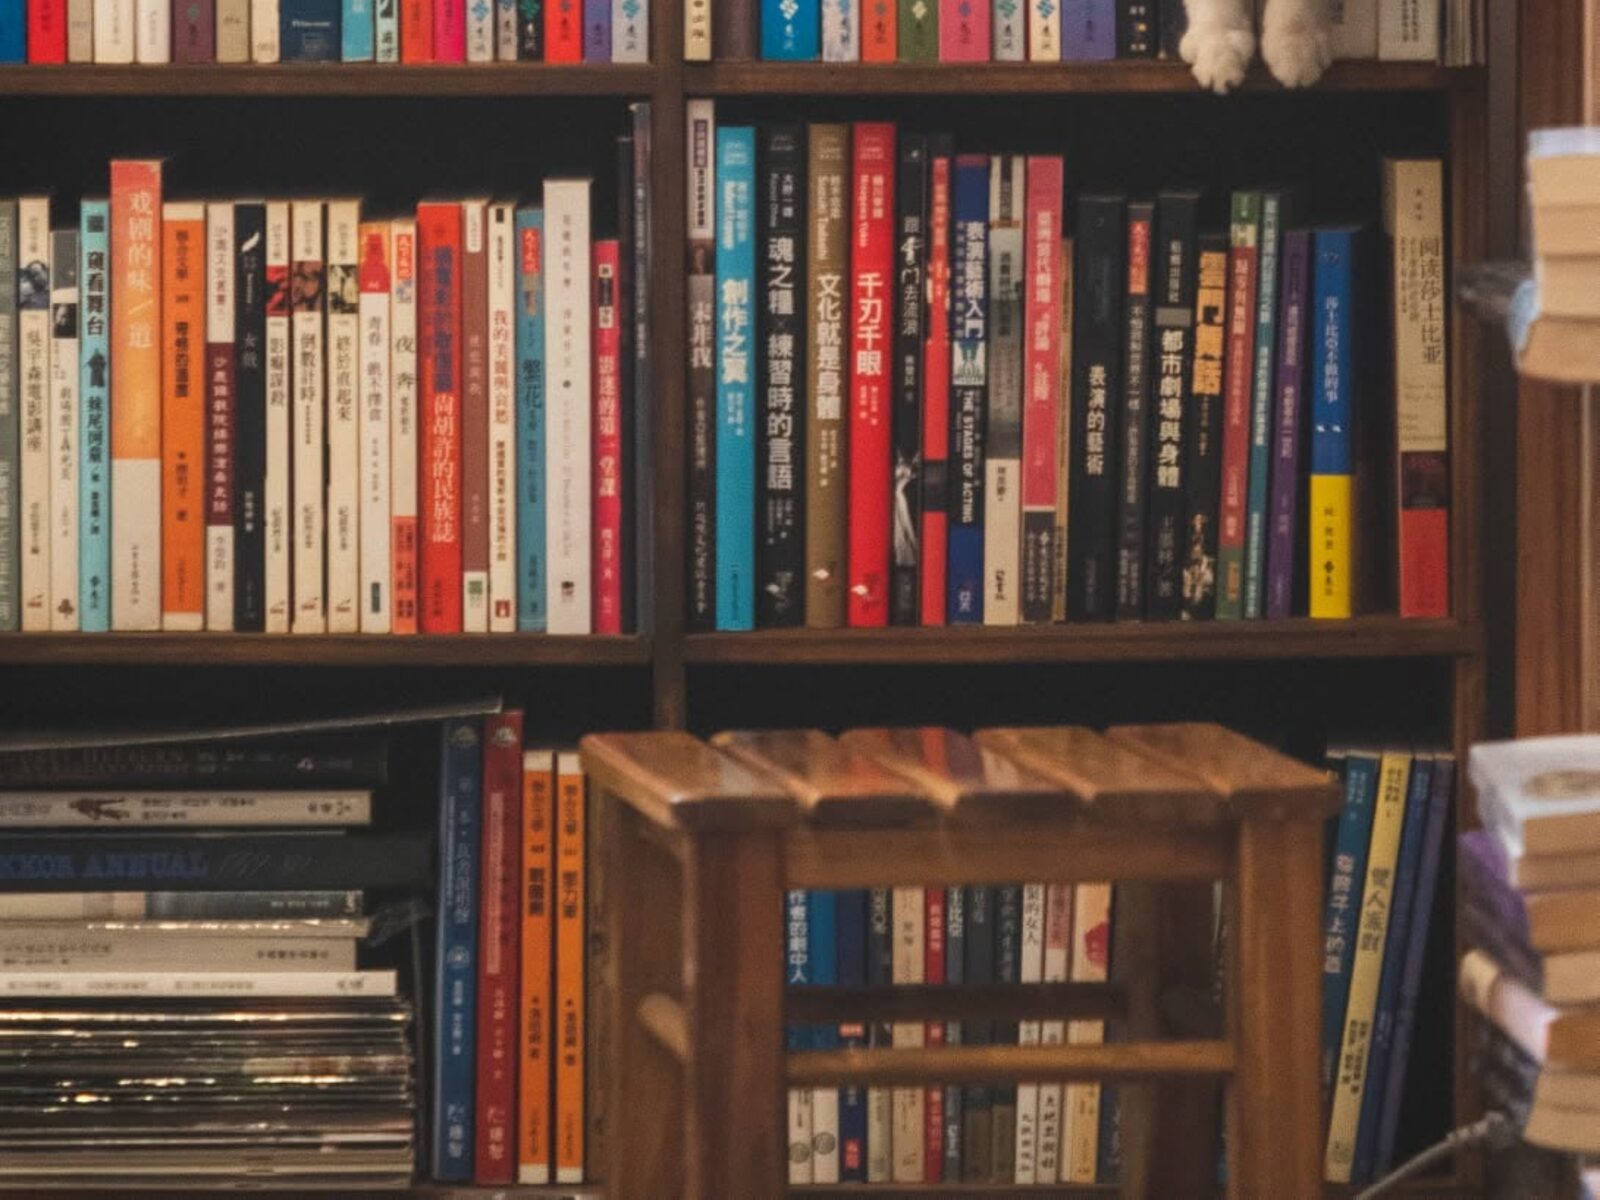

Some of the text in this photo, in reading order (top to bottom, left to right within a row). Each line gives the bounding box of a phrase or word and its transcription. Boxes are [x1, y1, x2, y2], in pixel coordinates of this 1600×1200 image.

[856, 272, 884, 376] 千刃千眼
[965, 221, 985, 338] 表演藝術入門
[1420, 237, 1443, 364] 阅读莎士比亚
[815, 274, 843, 420] 文化就是身體
[1157, 329, 1184, 488] 都市劇場與身體
[962, 391, 975, 524] THE STAGES OF ACTING
[1086, 365, 1106, 475] 表演的藝術
